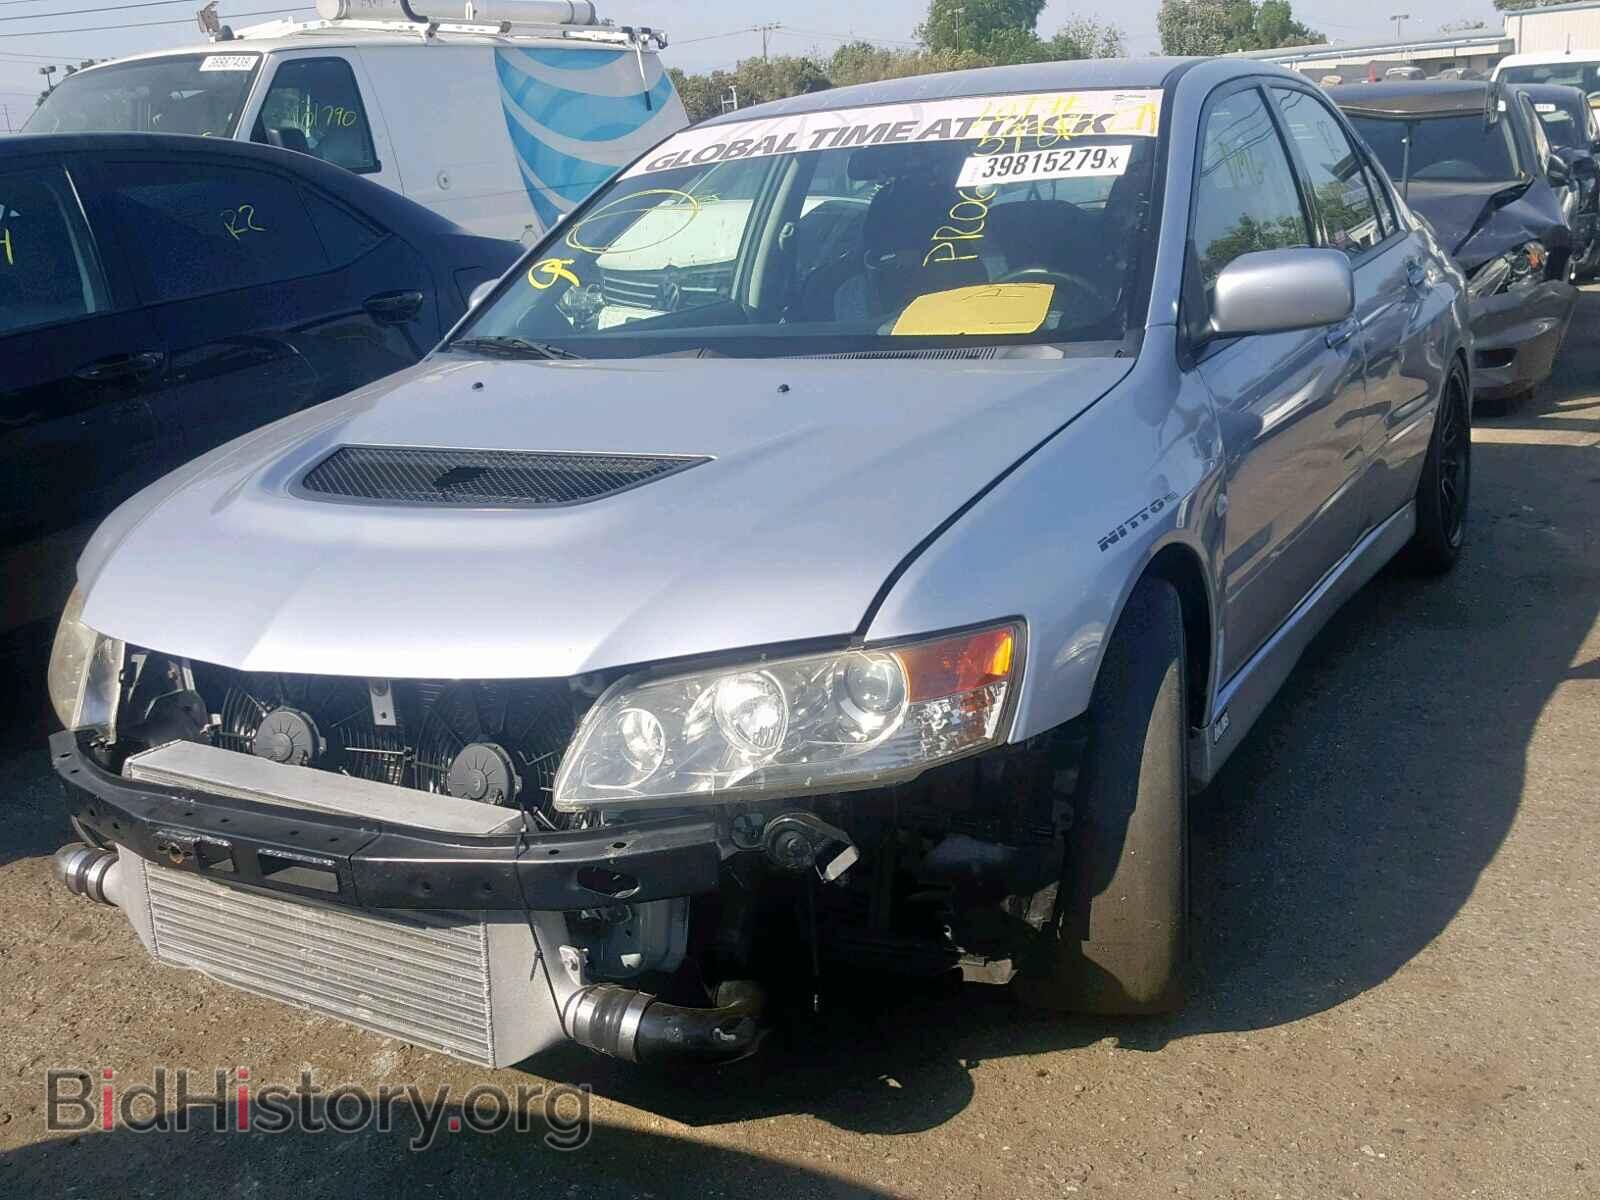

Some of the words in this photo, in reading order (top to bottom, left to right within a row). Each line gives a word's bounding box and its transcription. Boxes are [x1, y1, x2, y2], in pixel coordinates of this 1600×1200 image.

[645, 132, 803, 172] GLOBAL
[809, 120, 919, 149] TIME
[916, 113, 1116, 141] ATTACK
